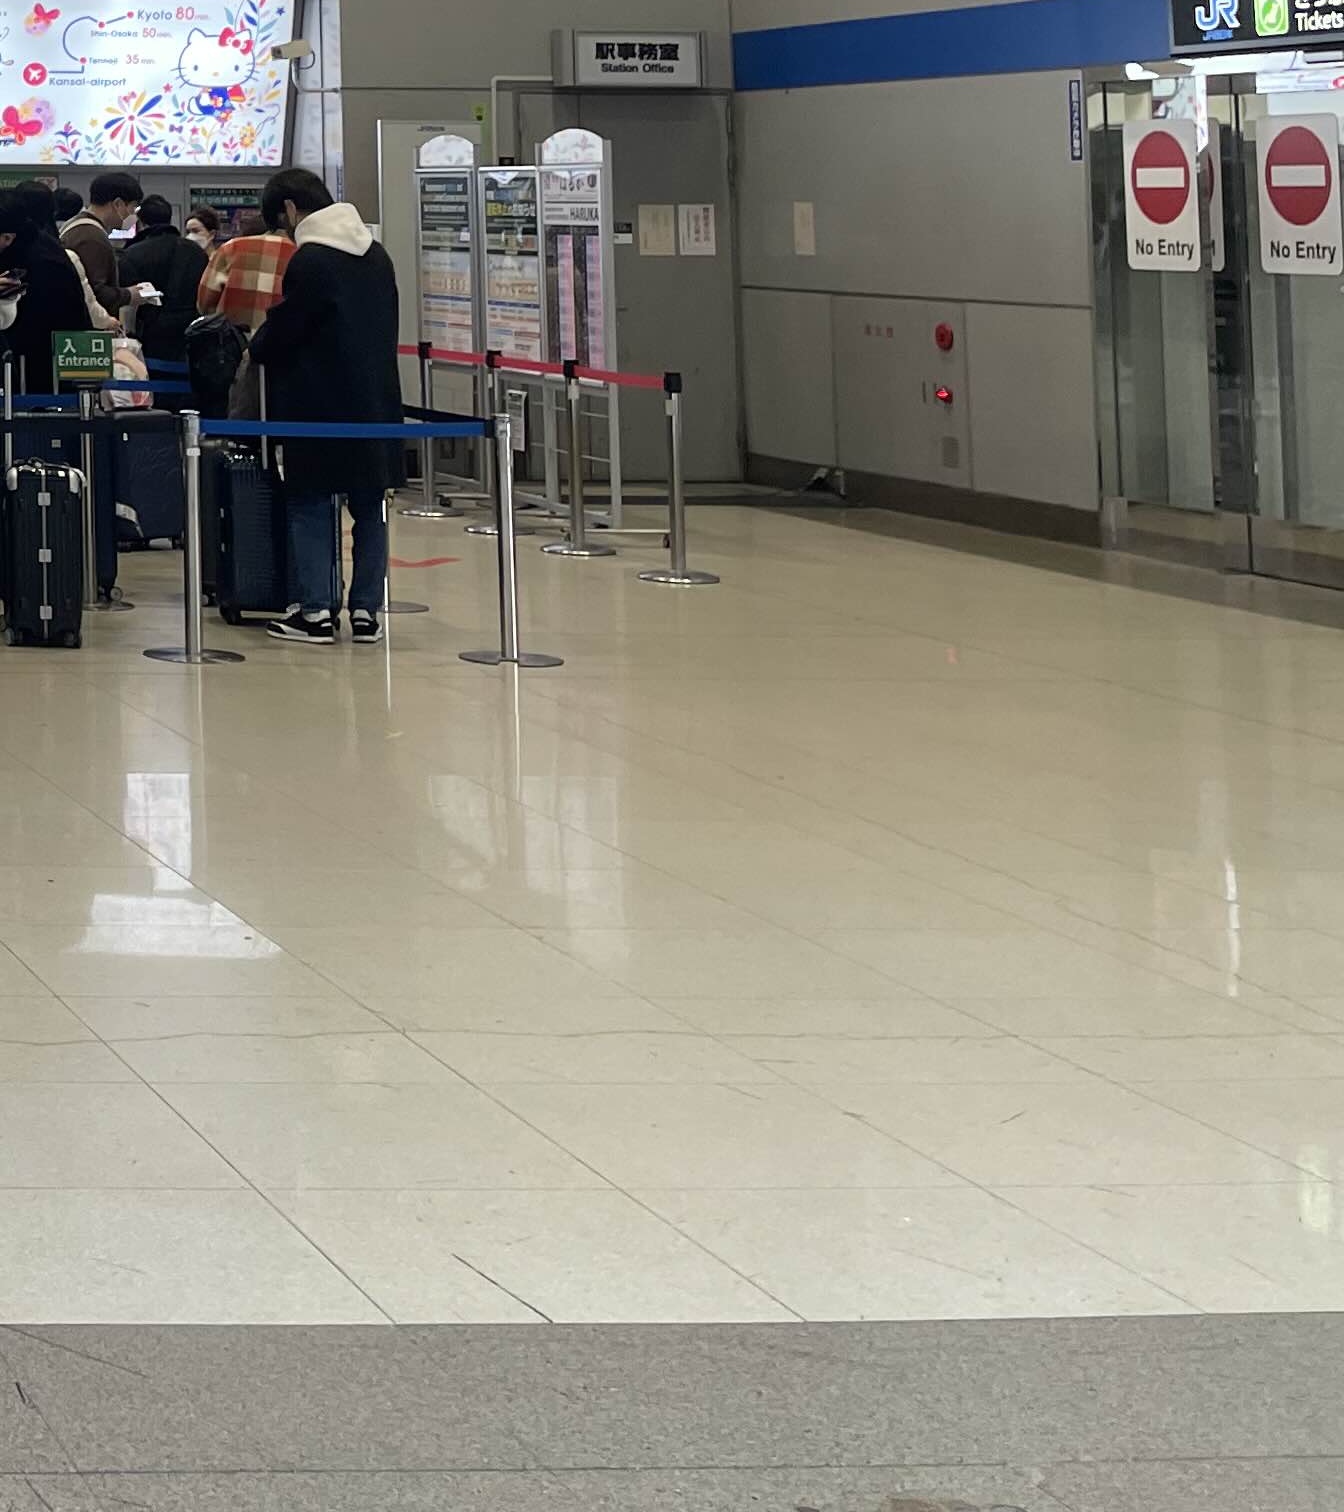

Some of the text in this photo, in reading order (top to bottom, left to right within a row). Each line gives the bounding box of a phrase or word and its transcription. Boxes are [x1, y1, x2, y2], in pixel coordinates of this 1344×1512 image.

[137, 9, 172, 22] Kyoto
[1294, 10, 1344, 32] Tickets
[601, 63, 674, 73] Station Office
[49, 78, 126, 87] Kansai-airport
[1135, 239, 1195, 261] No Entry
[1270, 240, 1337, 264] No Entry
[63, 338, 104, 353] 入口
[58, 355, 111, 367] Entrance
